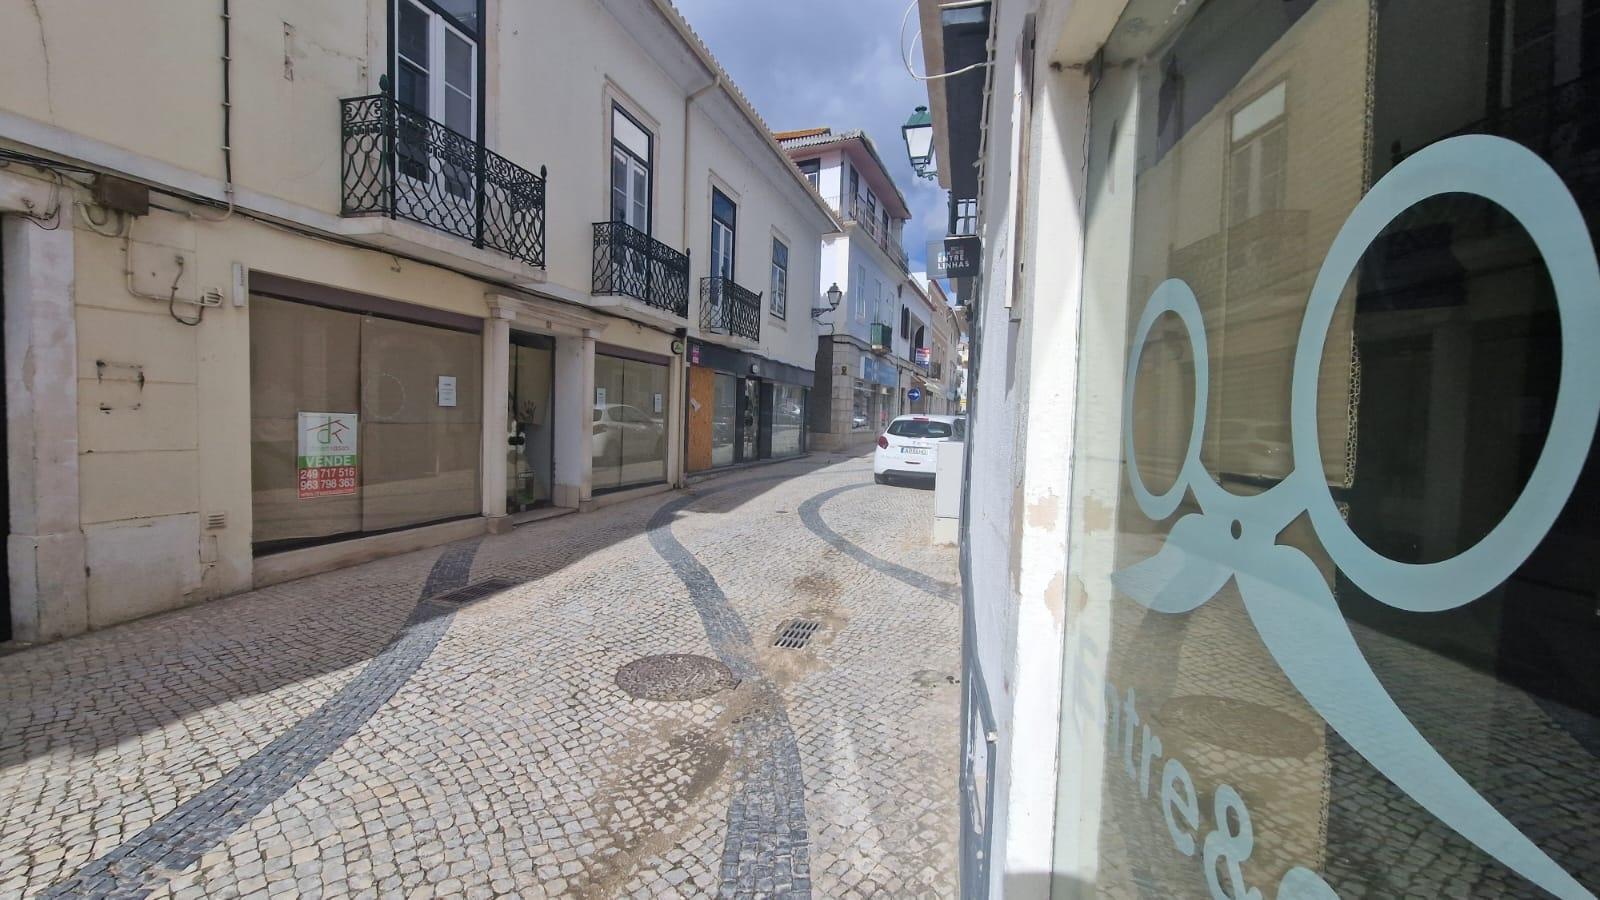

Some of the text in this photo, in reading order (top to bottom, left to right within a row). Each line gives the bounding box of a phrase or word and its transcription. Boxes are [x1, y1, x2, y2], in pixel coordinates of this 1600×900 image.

[937, 255, 965, 263] ENTRE
[937, 261, 970, 270] LINHAS
[305, 456, 351, 467] VENDE
[300, 467, 355, 480] 249 717 516
[300, 480, 319, 491] 963
[320, 479, 337, 489] 798
